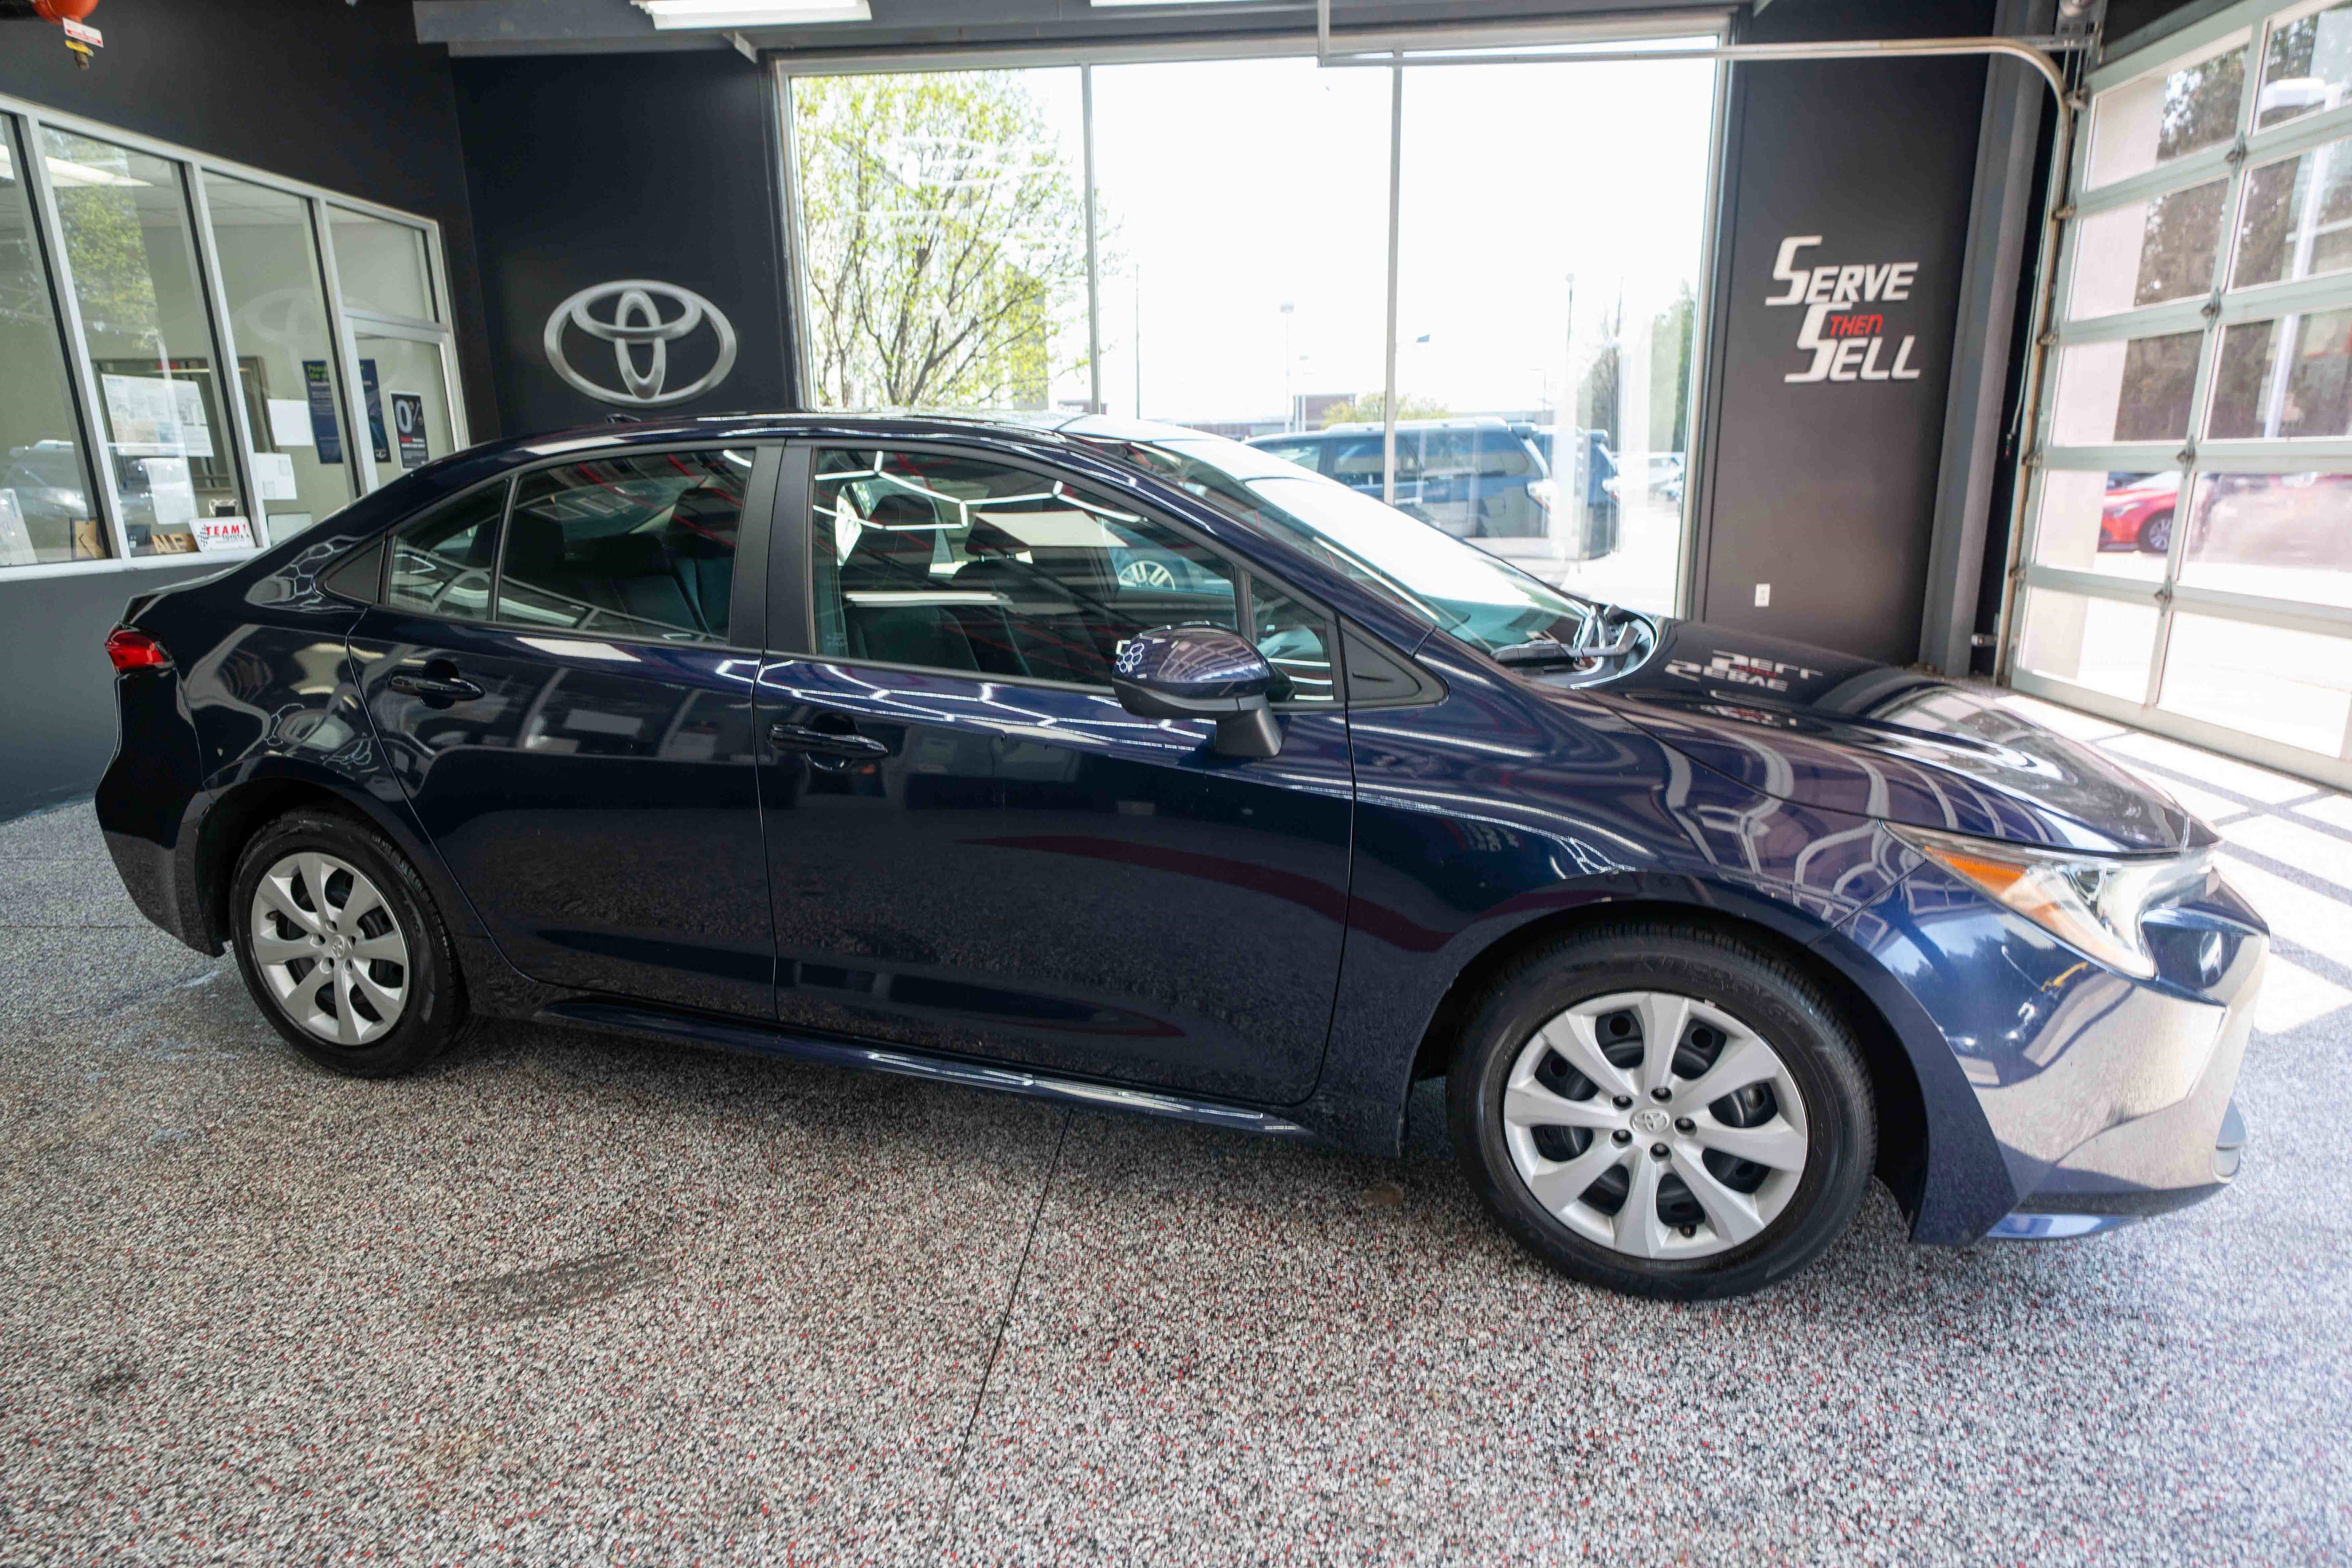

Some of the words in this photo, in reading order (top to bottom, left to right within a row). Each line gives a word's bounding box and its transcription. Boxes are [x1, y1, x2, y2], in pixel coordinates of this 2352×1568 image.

[1765, 235, 1918, 306] SERVE
[1784, 302, 1920, 383] SELL
[1830, 314, 1882, 336] THEN
[205, 525, 240, 536] TEAM
